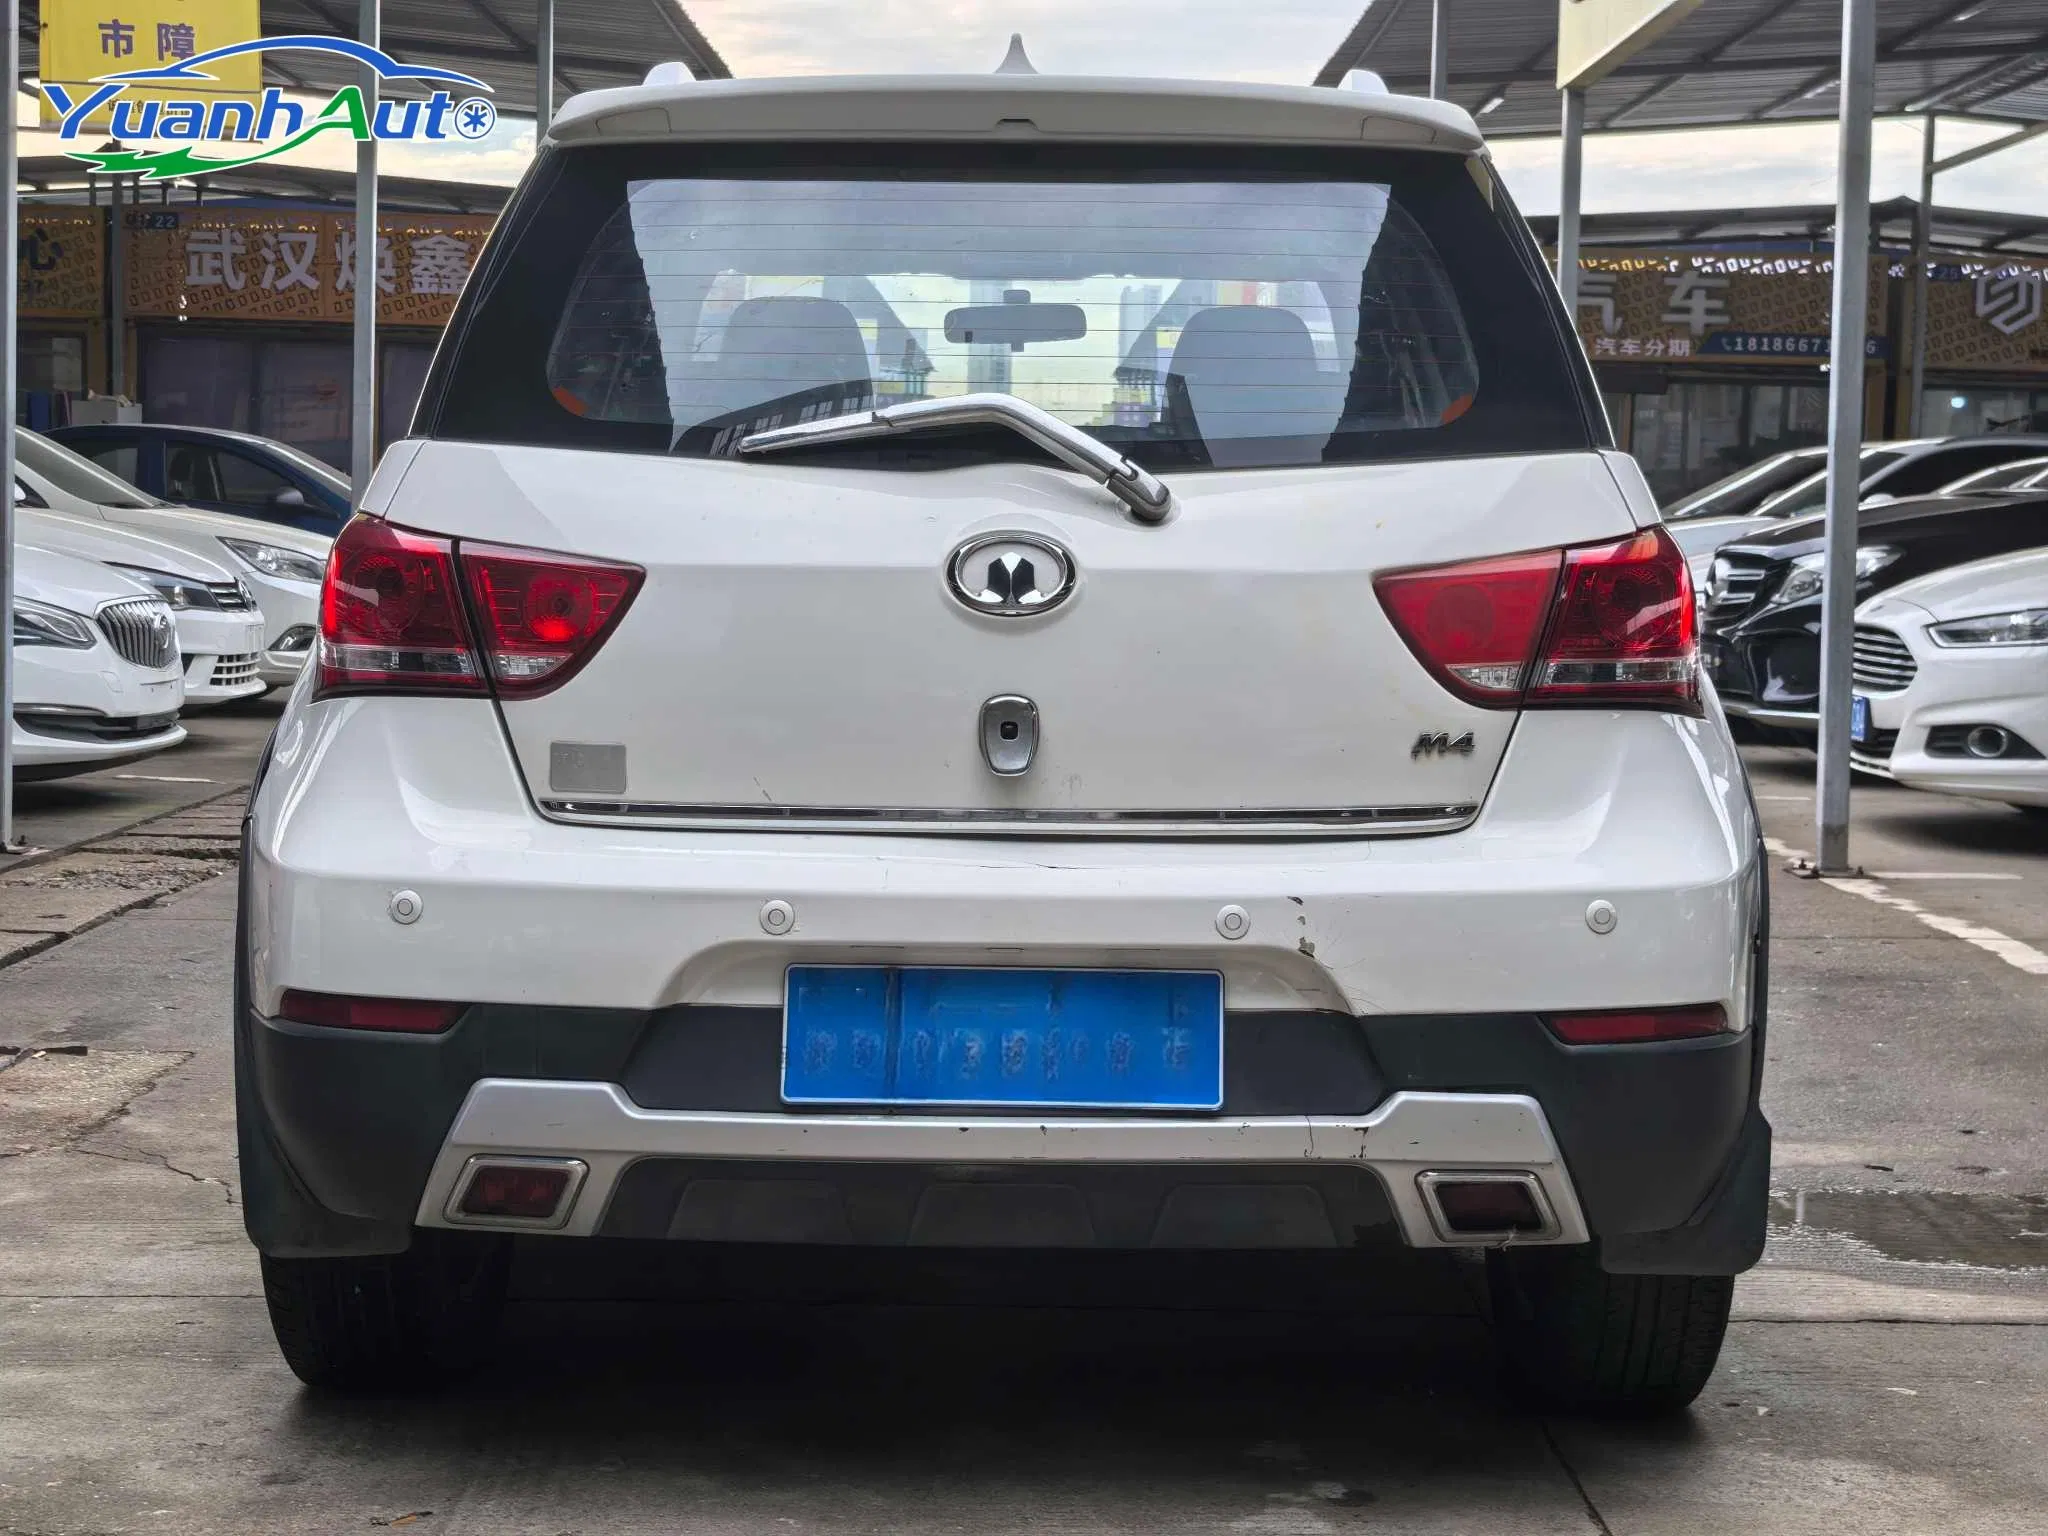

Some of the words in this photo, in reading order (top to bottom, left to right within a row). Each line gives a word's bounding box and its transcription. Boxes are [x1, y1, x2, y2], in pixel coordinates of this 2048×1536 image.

[1595, 337, 1690, 357] 汽车分期
[1411, 731, 1475, 758] M4
